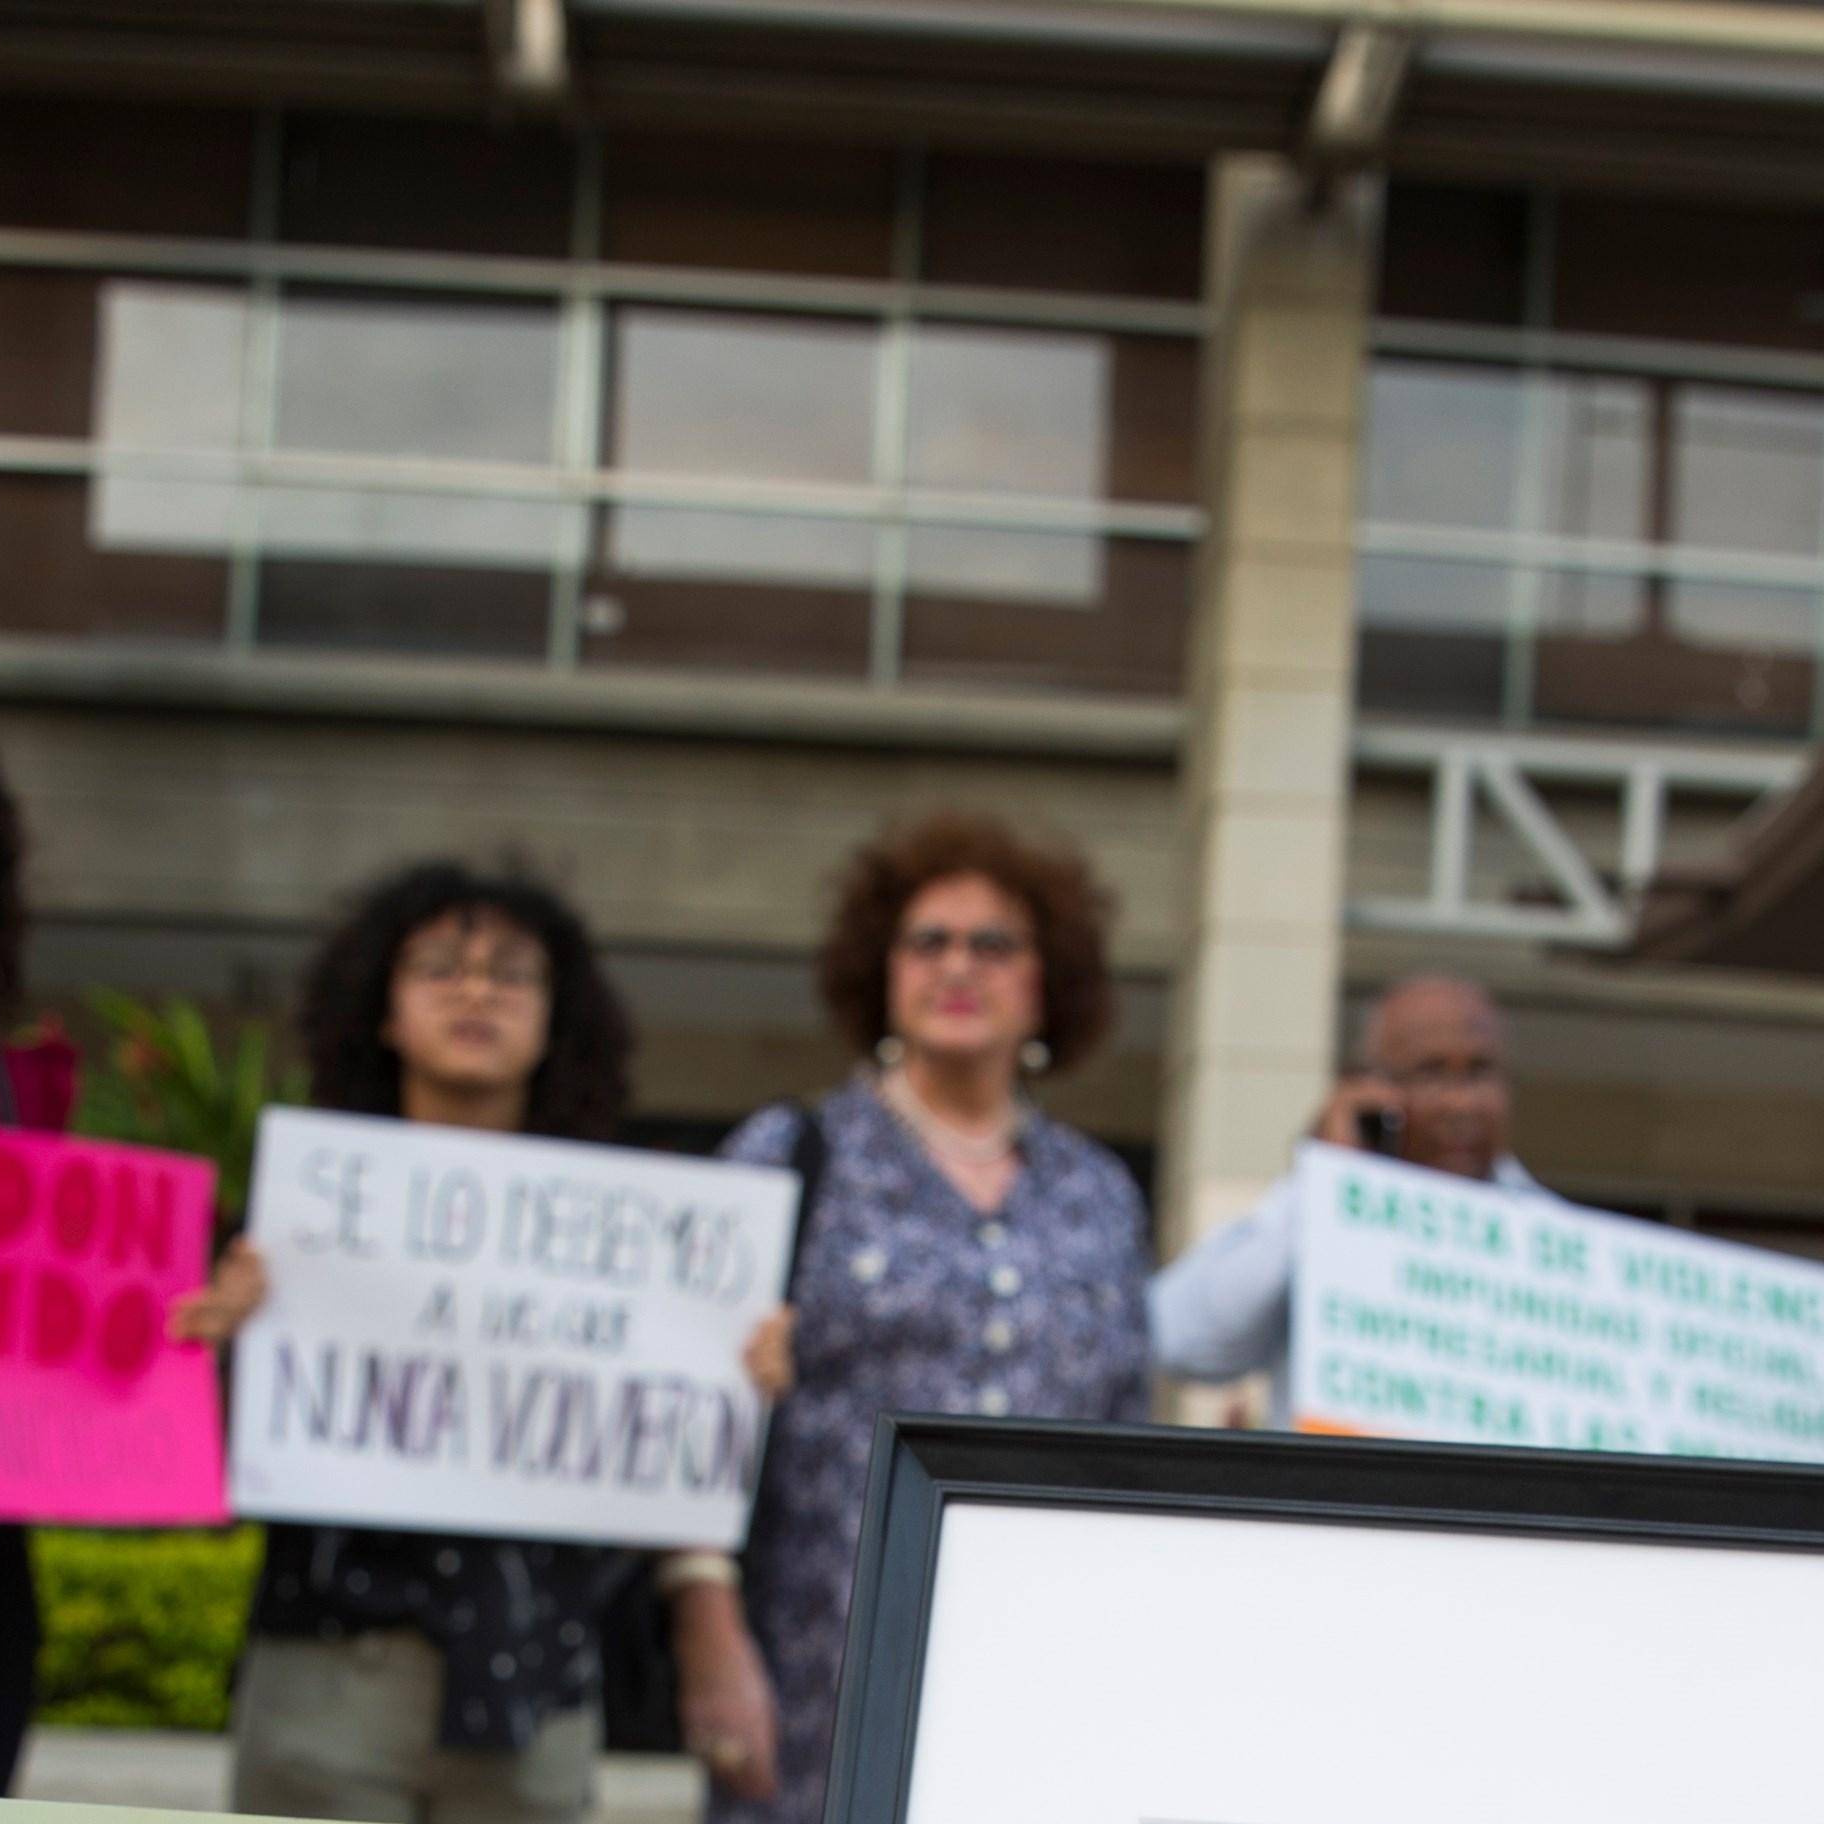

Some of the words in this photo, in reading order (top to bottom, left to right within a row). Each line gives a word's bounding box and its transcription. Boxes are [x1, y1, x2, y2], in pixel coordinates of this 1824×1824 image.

[292, 1146, 378, 1258] SE
[404, 1160, 487, 1266] LO
[1336, 1174, 1510, 1258] BASTA
[1529, 1221, 1589, 1274] DE
[414, 1278, 460, 1334] A
[1321, 1292, 1628, 1396] EMPRESARIAL
[1398, 1256, 1642, 1342] IMPUNIDAD
[268, 1336, 472, 1470] NUNCA
[1320, 1352, 1528, 1439] CONTRA
